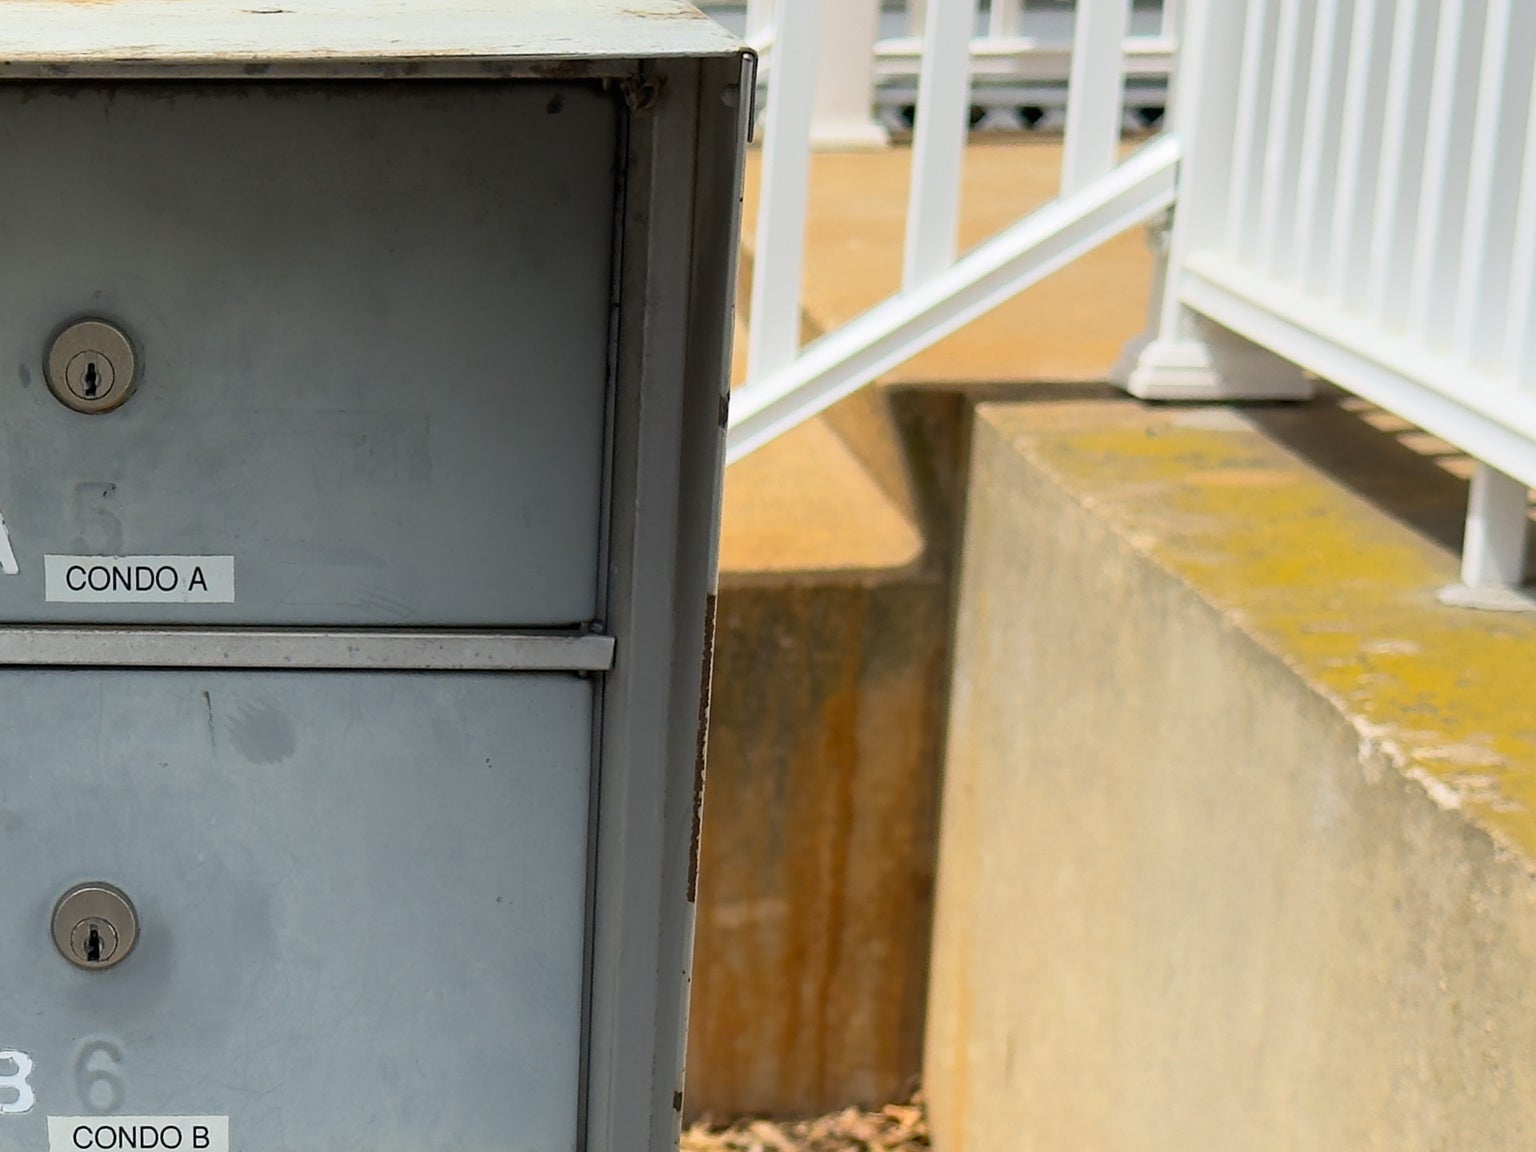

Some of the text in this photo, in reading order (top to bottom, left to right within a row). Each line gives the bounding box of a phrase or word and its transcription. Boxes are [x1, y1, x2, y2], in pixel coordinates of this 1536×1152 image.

[65, 565, 208, 593] CONDO A
[73, 1039, 126, 1114] 6
[72, 1125, 210, 1150] CONDO B
